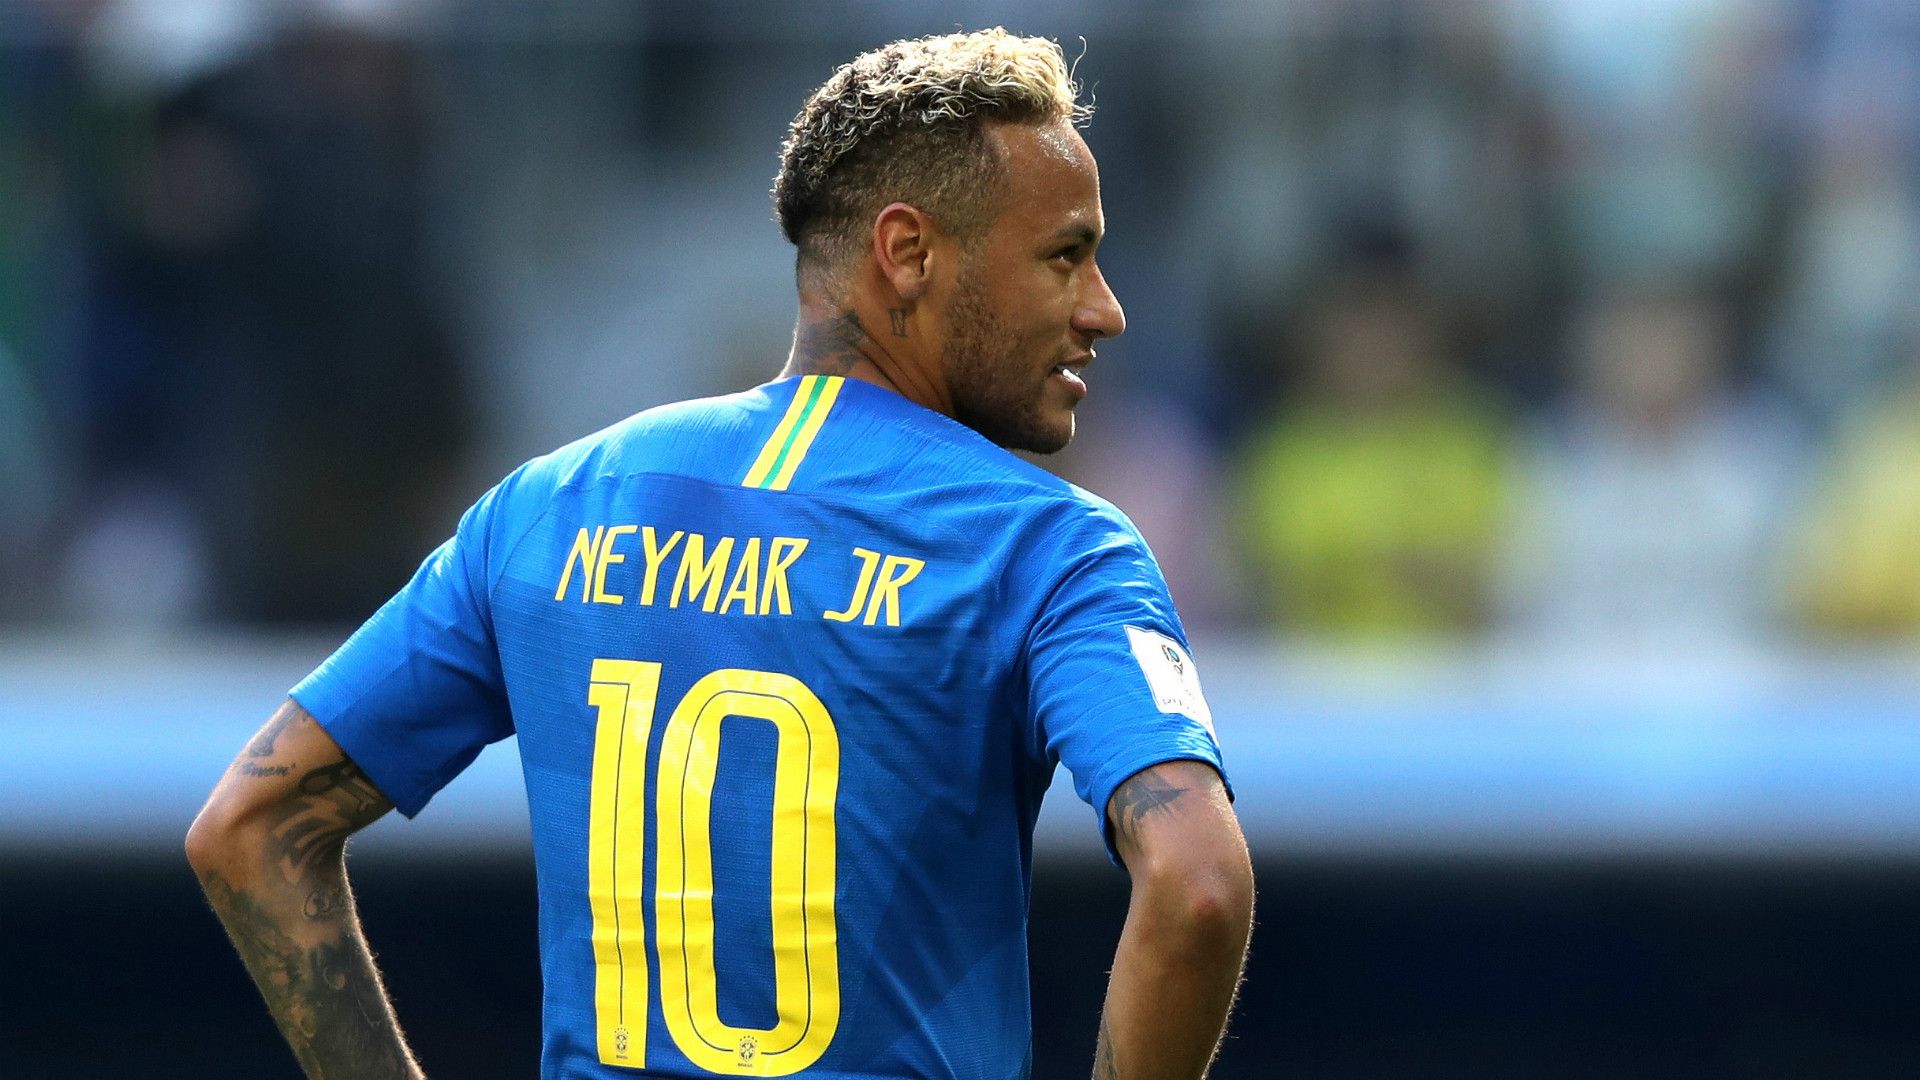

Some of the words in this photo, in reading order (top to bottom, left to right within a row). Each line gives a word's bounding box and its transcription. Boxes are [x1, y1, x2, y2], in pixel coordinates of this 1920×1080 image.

[554, 525, 809, 615] NEYMAR
[823, 547, 925, 627] JR
[588, 660, 840, 1078] 10
